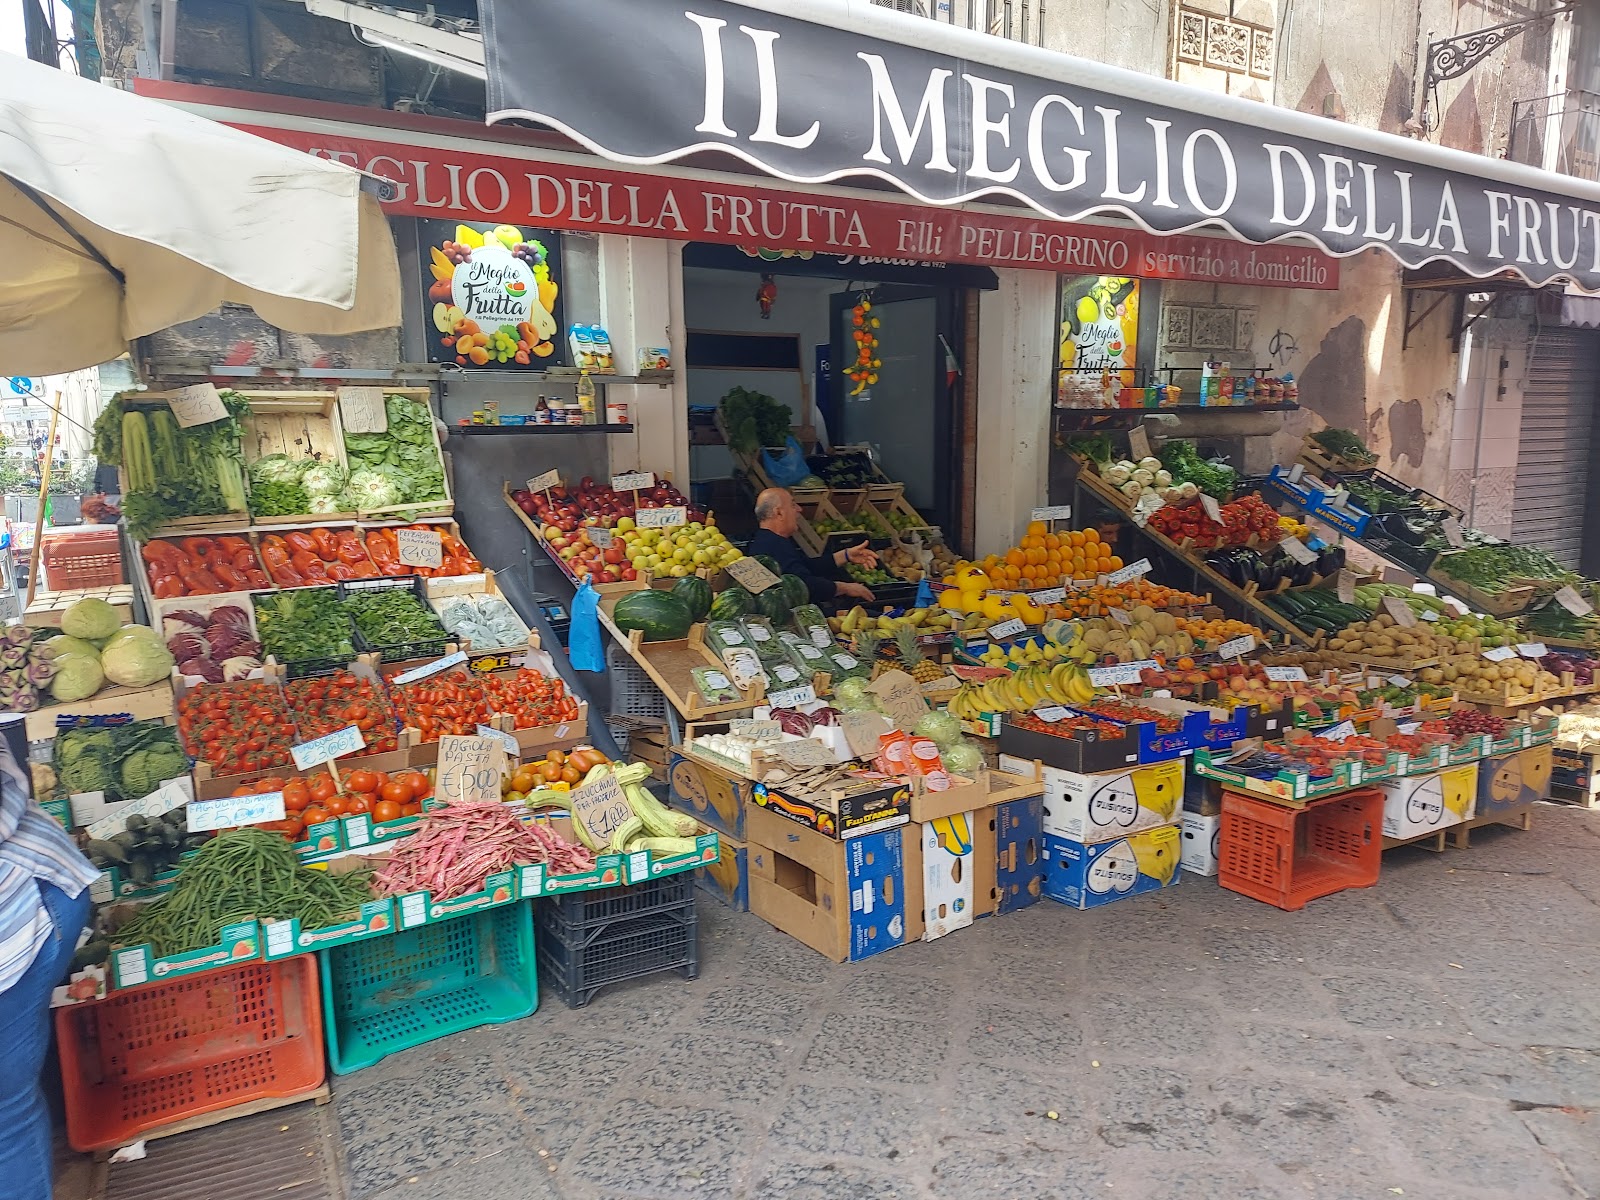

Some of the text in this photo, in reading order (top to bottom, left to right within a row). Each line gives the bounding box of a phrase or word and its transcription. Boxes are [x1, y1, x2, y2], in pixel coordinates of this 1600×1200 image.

[685, 10, 1600, 273] IL MEGLIO DELLA FRUT
[308, 147, 1327, 285] GLIO DELLA FRUTTA F.lli PELLEGRINO servizio a domicilio
[469, 262, 521, 284] il Meglio
[462, 280, 527, 316] Frutta
[482, 285, 503, 295] della
[1081, 323, 1120, 346] Meglio
[1075, 342, 1119, 375] Frutta
[445, 750, 490, 764] PASTA
[863, 807, 900, 822] D'ANNA
[1095, 800, 1134, 815] SQUISITA
[1094, 868, 1133, 882] SQUISITA
